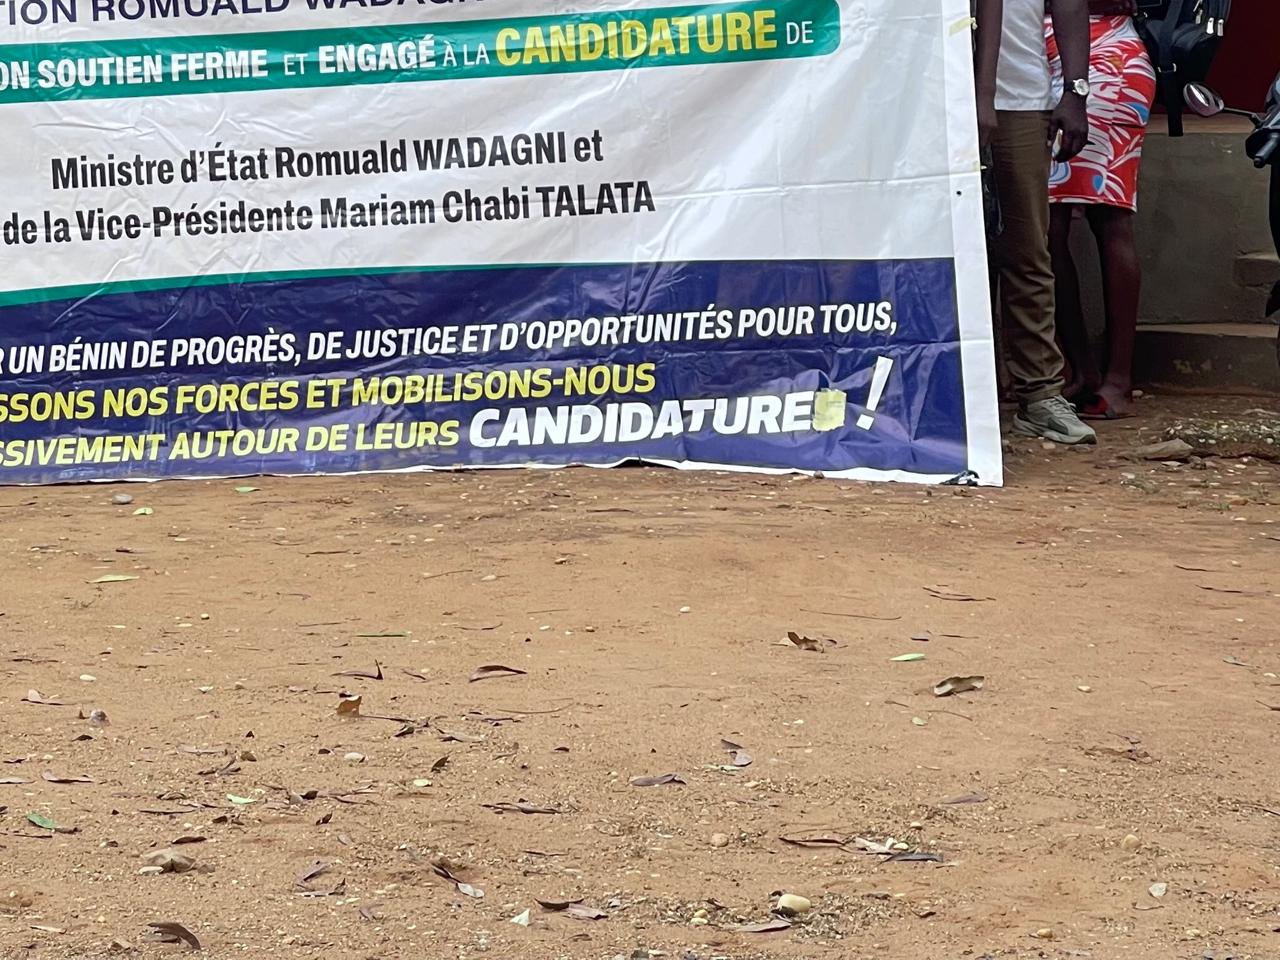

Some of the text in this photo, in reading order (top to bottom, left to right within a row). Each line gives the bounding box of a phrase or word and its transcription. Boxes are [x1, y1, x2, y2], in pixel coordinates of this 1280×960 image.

[37, 55, 163, 89] SOUTIEN
[171, 49, 269, 82] FERME
[284, 52, 309, 76] ET
[319, 34, 436, 74] ENGAGÉ
[443, 40, 458, 67] À
[463, 42, 491, 66] LA
[495, 10, 778, 67] CANDIDATURE
[786, 20, 814, 45] DE
[51, 129, 604, 189] Ministre d’État Romuald WADAGNI et
[3, 181, 656, 245] de la Vice-Présidente Mariam Chabi TALATA
[9, 345, 45, 374] UN
[49, 337, 127, 372] BÉNIN
[131, 340, 167, 368] DE
[170, 327, 302, 367] PROGRÈS,
[307, 331, 344, 361] DE
[345, 326, 457, 360] JUSTICE
[462, 324, 497, 353] ET
[499, 304, 732, 351] D’OPPORTUNITÉS
[738, 306, 815, 338] POUR
[820, 301, 898, 335] TOUS,
[102, 386, 169, 418] NOS
[176, 380, 299, 415] FORCES
[306, 378, 347, 409] ET
[351, 362, 656, 406] MOBILISONS-NOUS
[169, 427, 300, 460] AUTOUR
[305, 423, 350, 452] DE
[355, 420, 460, 451] LEURS
[469, 388, 846, 449] CANDIDATURE
[856, 355, 894, 431] !
